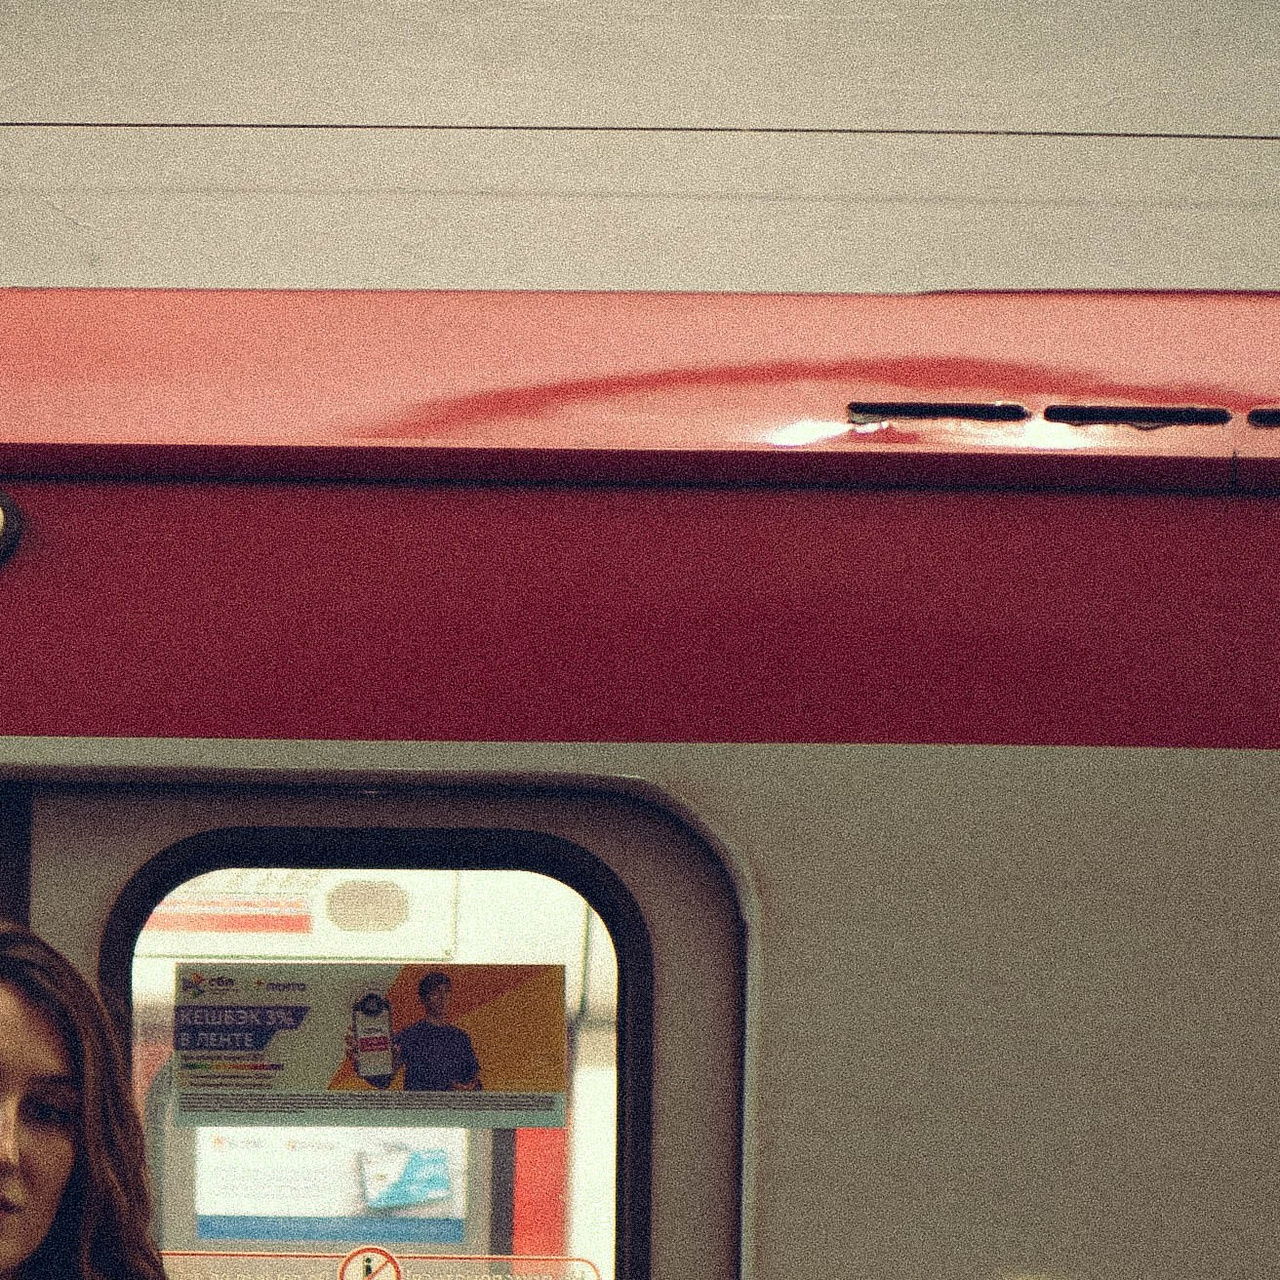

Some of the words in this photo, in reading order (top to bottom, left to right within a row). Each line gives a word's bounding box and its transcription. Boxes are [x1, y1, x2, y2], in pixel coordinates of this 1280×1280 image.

[180, 1010, 262, 1026] КЕШБЭК
[180, 1032, 191, 1046] В
[196, 1032, 255, 1047] ЛЕНТЕ
